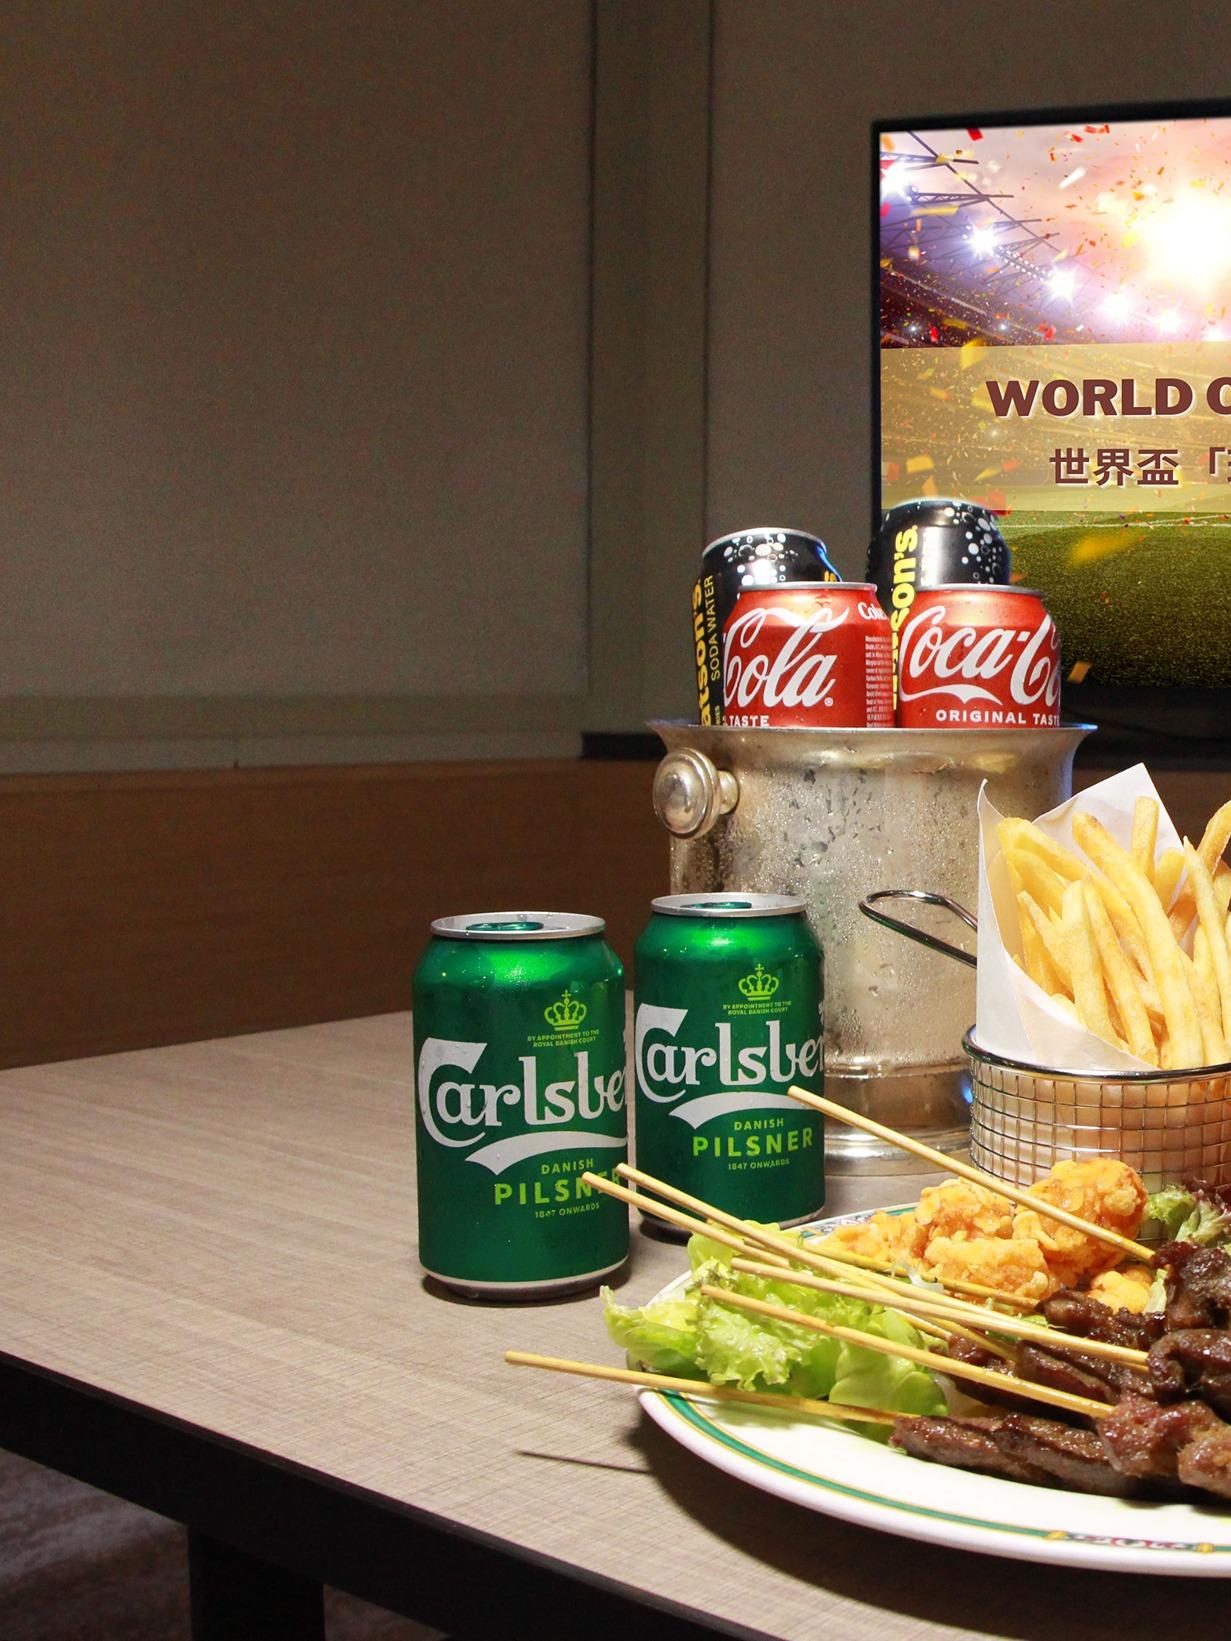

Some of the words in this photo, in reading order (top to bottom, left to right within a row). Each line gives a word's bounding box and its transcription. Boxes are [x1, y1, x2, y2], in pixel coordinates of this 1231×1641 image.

[985, 377, 1194, 418] WORLD
[704, 575, 717, 632] WATER
[708, 633, 720, 682] SODA
[729, 715, 769, 727] TASTE
[936, 709, 1026, 724] ORIGINAL
[418, 1037, 627, 1148] Carlsbe
[734, 1118, 784, 1131] DANISH
[693, 1127, 813, 1157] PILSNER
[541, 1158, 594, 1174] DANISH
[728, 1162, 747, 1170] 1847
[750, 1158, 790, 1169] ONWARDS
[559, 1202, 600, 1216] ONWARDS
